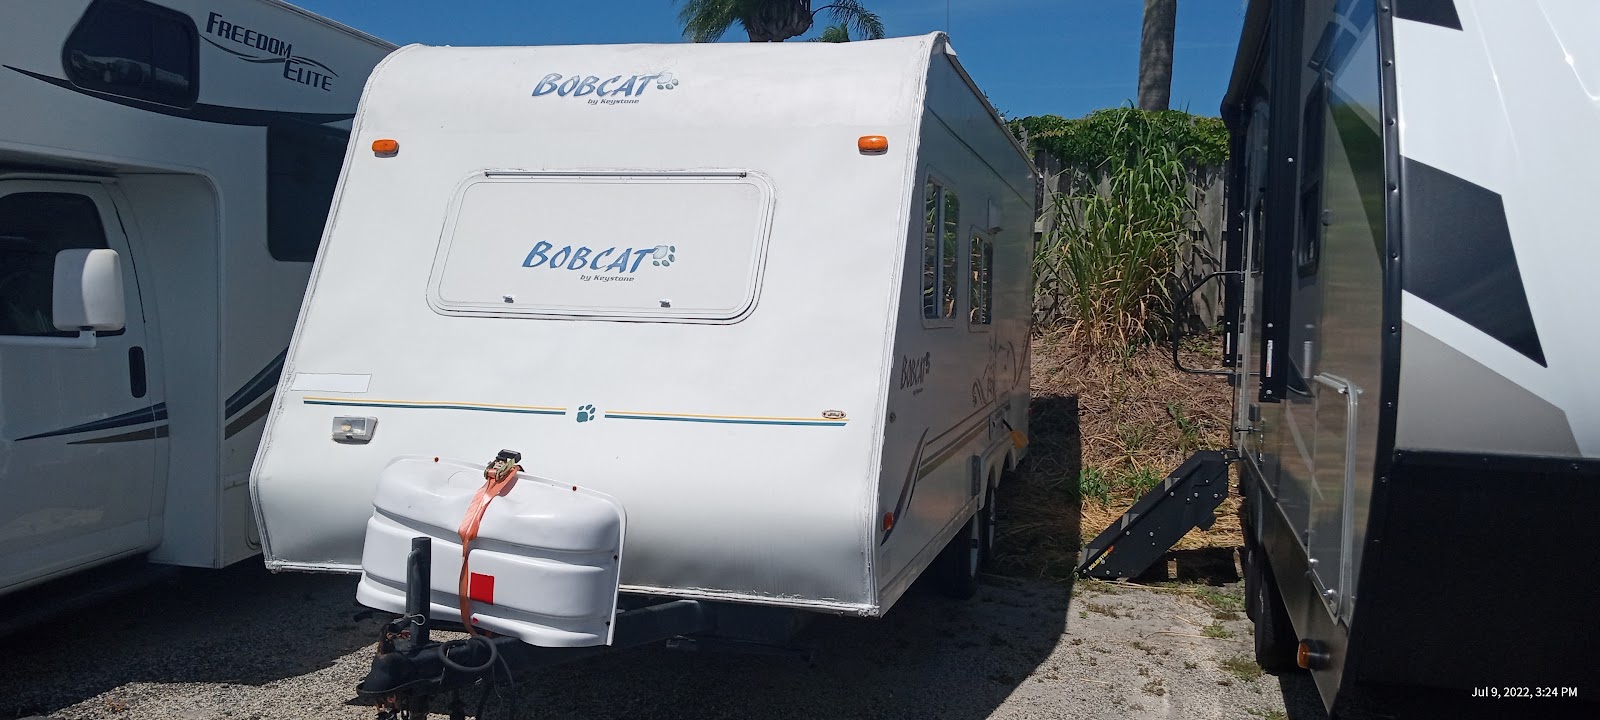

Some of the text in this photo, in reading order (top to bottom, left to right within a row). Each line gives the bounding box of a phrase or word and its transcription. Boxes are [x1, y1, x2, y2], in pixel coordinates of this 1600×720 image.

[206, 11, 292, 58] FREEDOM
[283, 59, 333, 92] ELITE
[531, 72, 661, 97] BOBCAT
[587, 98, 640, 106] by Keystone
[521, 239, 659, 274] BOBCAT
[580, 274, 635, 283] by Keystone
[900, 354, 926, 390] BOBCAT
